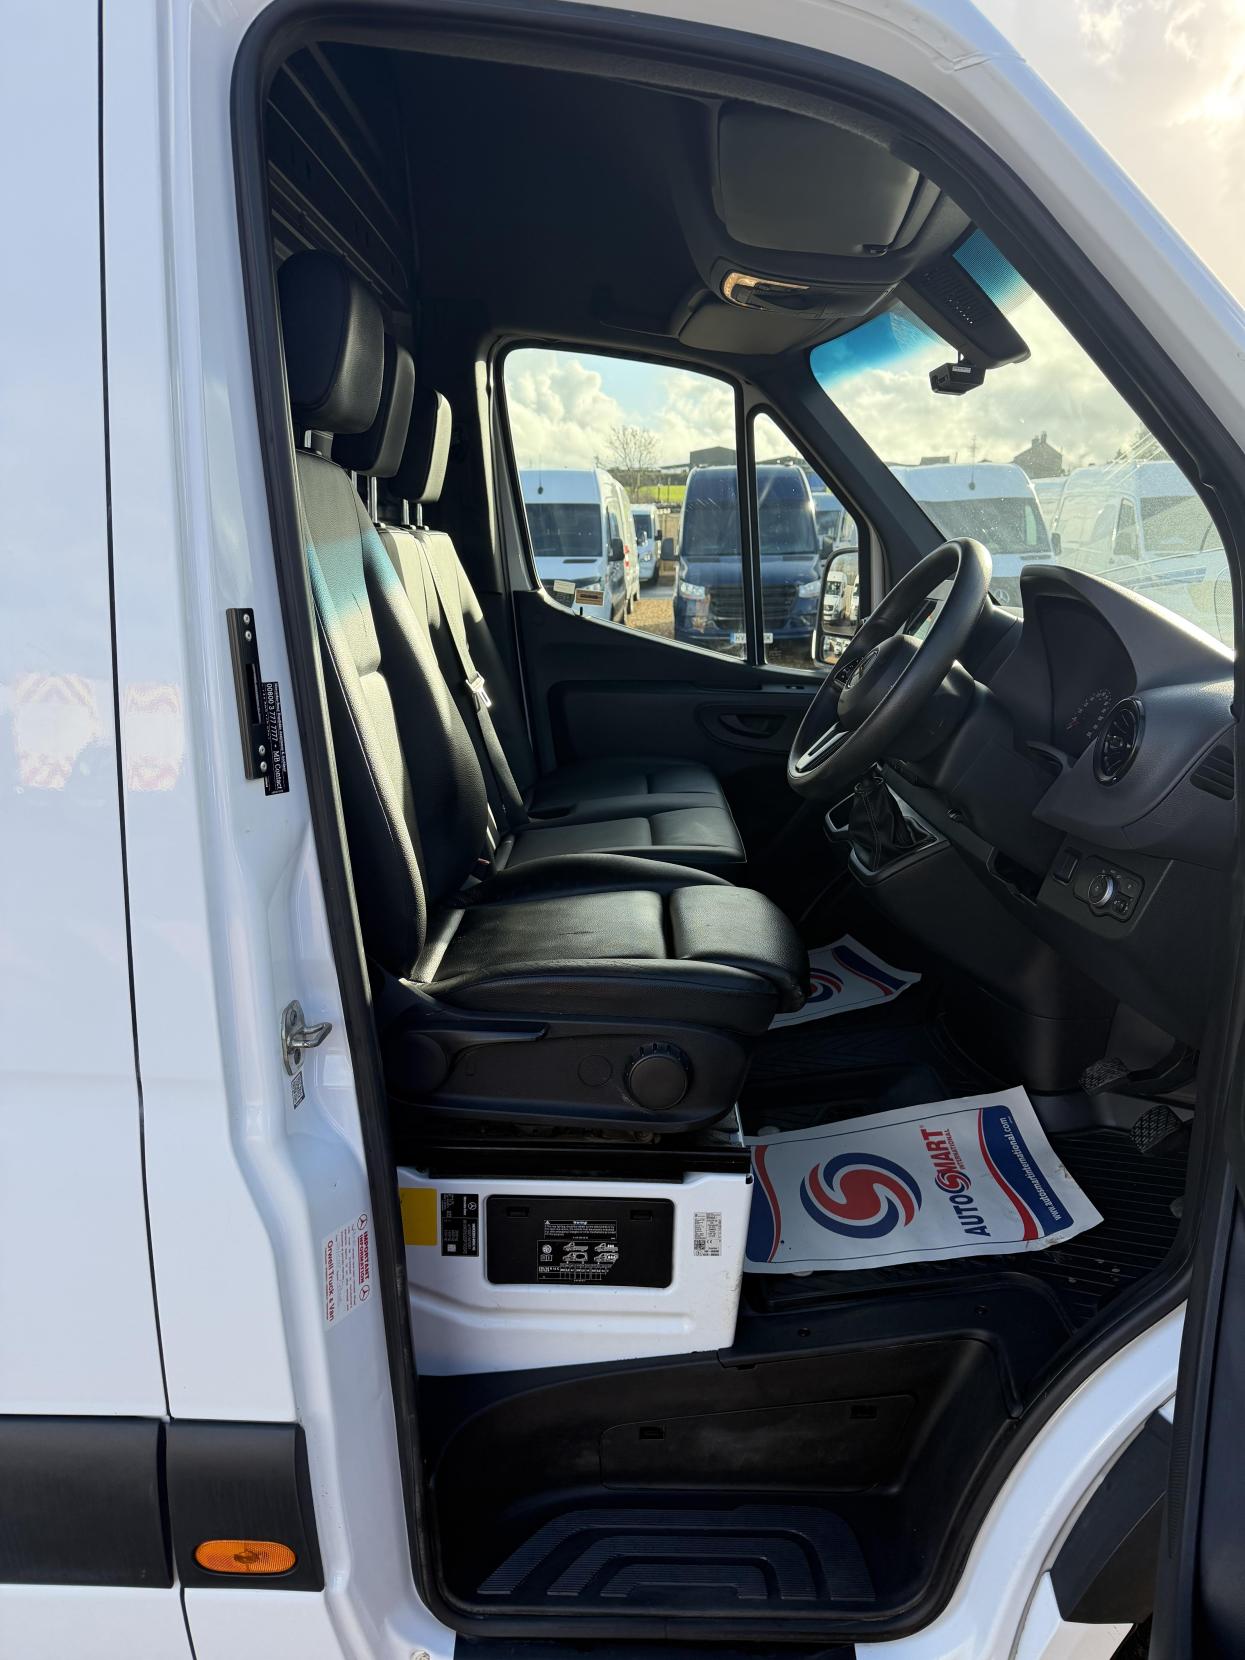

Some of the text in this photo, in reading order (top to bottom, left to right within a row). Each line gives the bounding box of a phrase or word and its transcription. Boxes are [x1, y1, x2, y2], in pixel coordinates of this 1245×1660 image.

[273, 751, 280, 762] MB
[275, 763, 283, 789] Contact
[944, 1128, 966, 1170] INTERNATIONAL
[1000, 1117, 1062, 1221] www.autosmartinternational.com
